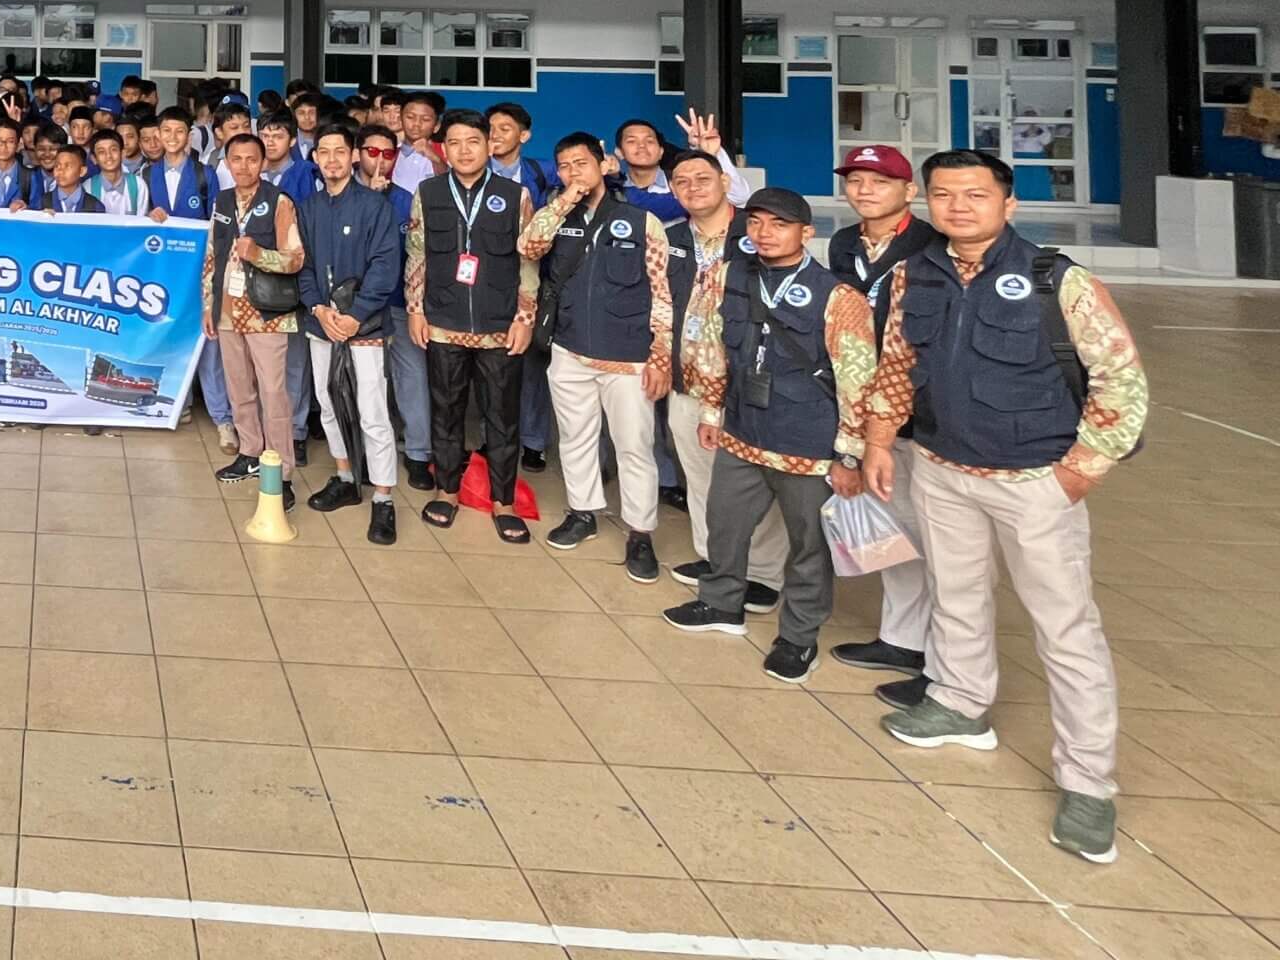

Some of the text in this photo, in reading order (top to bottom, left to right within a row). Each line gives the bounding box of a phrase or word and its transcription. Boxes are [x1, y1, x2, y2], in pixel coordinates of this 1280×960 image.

[31, 260, 168, 318] CLASS
[11, 300, 34, 315] AL
[39, 303, 119, 334] AKHYAR
